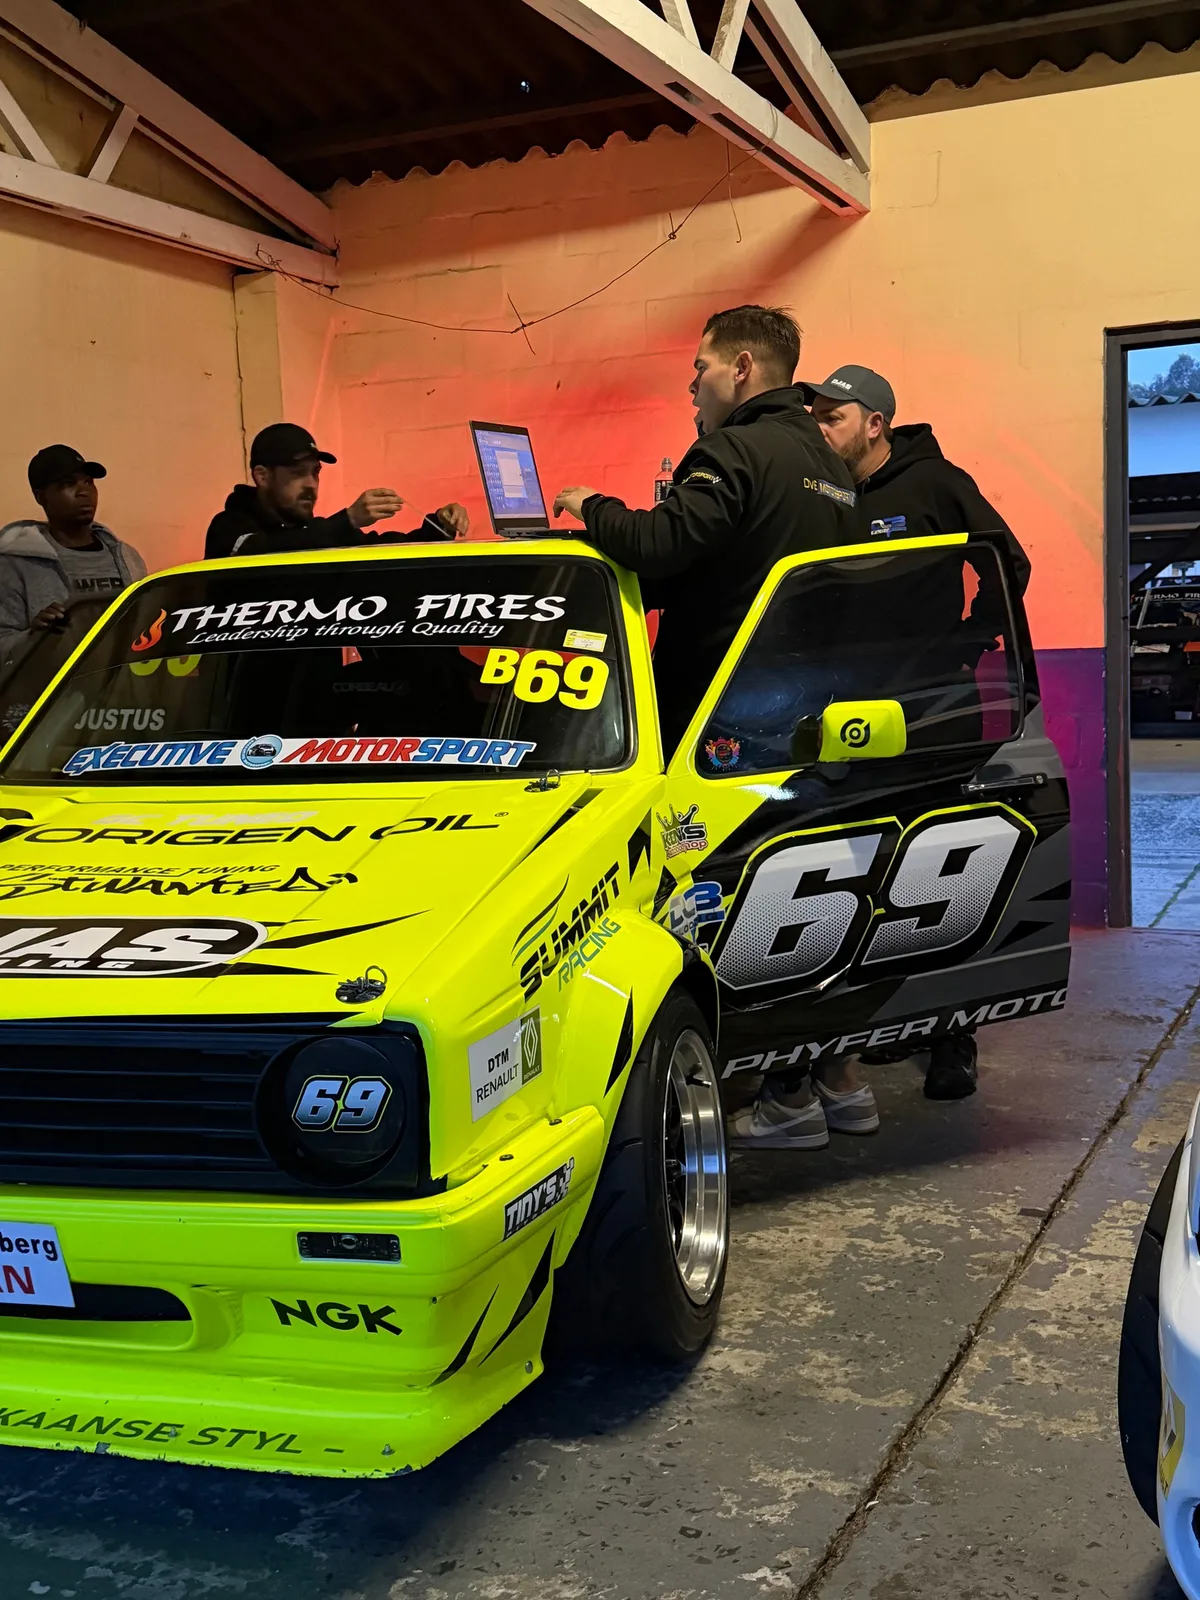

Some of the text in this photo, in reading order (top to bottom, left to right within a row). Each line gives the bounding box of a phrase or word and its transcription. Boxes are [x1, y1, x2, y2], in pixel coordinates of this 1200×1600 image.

[171, 593, 567, 633] THERMO FIRES
[186, 619, 505, 645] Leadership through Quality
[480, 648, 609, 711] B69
[74, 708, 167, 731] JUSTUS
[65, 740, 237, 775] EXECUTIVE
[282, 737, 536, 767] MOTORSPORT
[24, 825, 356, 846] ORIGEN
[0, 864, 280, 876] PERFORMANCE TUNING
[715, 814, 1021, 991] 69
[519, 861, 621, 1001] SUMMIT
[558, 917, 622, 993] RACING
[488, 1048, 509, 1073] DTM
[720, 1015, 939, 1079] PHYFER
[476, 1063, 519, 1103] RENAULT
[294, 1076, 390, 1132] 69
[506, 1174, 557, 1232] TINY'S
[0, 1264, 35, 1295] N
[266, 1297, 403, 1336] NGK
[187, 1425, 303, 1455] STYL
